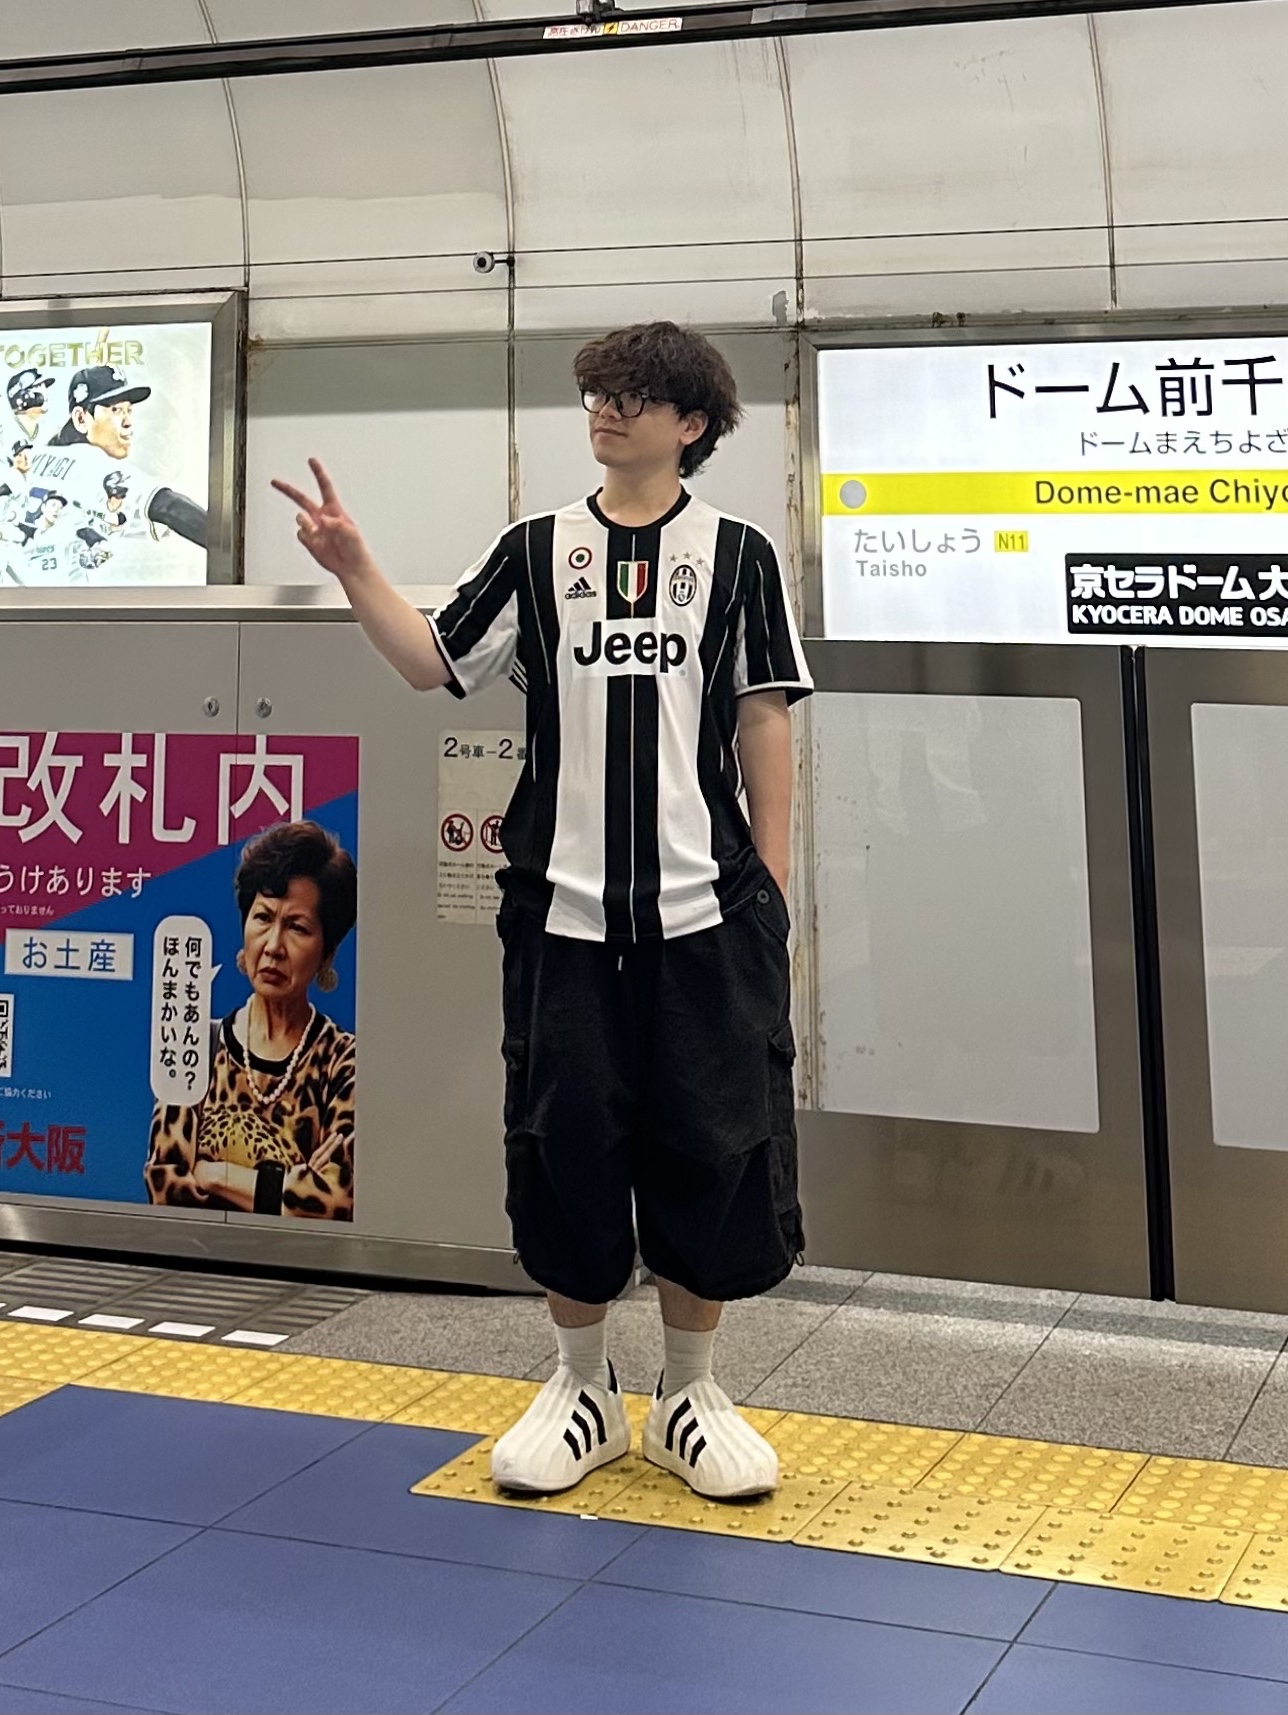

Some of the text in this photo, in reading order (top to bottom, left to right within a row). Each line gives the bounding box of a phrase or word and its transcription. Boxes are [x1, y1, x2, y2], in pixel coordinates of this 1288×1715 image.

[620, 20, 678, 32] DANGER
[987, 355, 1283, 419] ドーム前千
[1035, 480, 1199, 504] Dome-mae
[854, 528, 981, 555] たいしょう
[997, 533, 1027, 551] N11
[42, 558, 58, 571] 23
[856, 560, 927, 578] Taisho
[564, 591, 597, 599] adidas
[1070, 563, 1288, 600] 京セラドーム大
[1072, 605, 1174, 625] KYOCERA
[1179, 605, 1244, 626] DOME
[574, 622, 687, 673] Jeep
[0, 731, 304, 845] 改札内
[0, 864, 151, 898] うけあります
[22, 938, 117, 972] お土産
[159, 936, 180, 1079] ほんまかいな。
[182, 936, 203, 1091] 何でもあんの？
